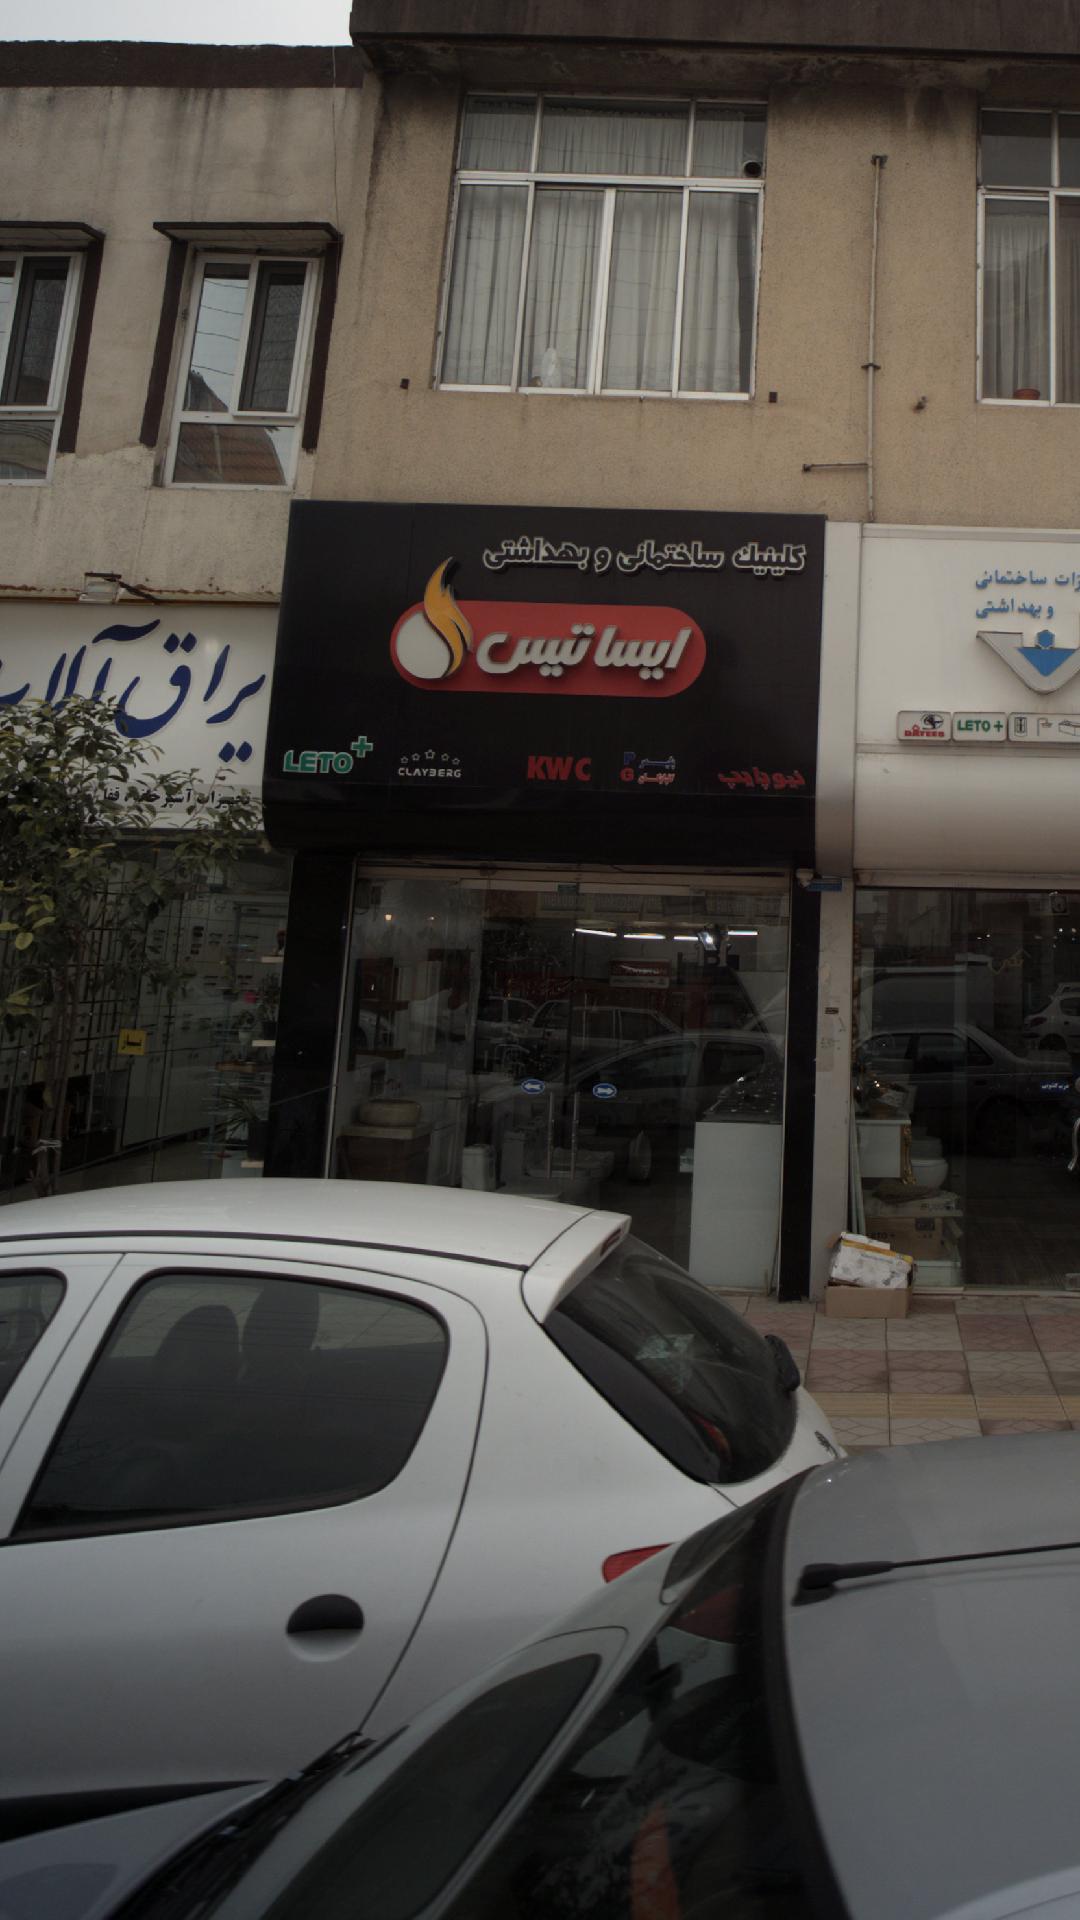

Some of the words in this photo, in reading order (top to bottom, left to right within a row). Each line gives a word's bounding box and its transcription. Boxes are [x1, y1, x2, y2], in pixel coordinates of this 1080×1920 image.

[483, 536, 589, 570] بهداشتی
[594, 546, 611, 575] و
[616, 539, 724, 573] ساختمانی
[975, 569, 1047, 590] ساختمانی
[975, 598, 1042, 619] بهداشتی
[1046, 606, 1054, 619] و
[475, 623, 694, 681] ایساتیس
[957, 720, 990, 732] LETO
[397, 767, 462, 779] CLAYBERG
[526, 756, 593, 783] KWC
